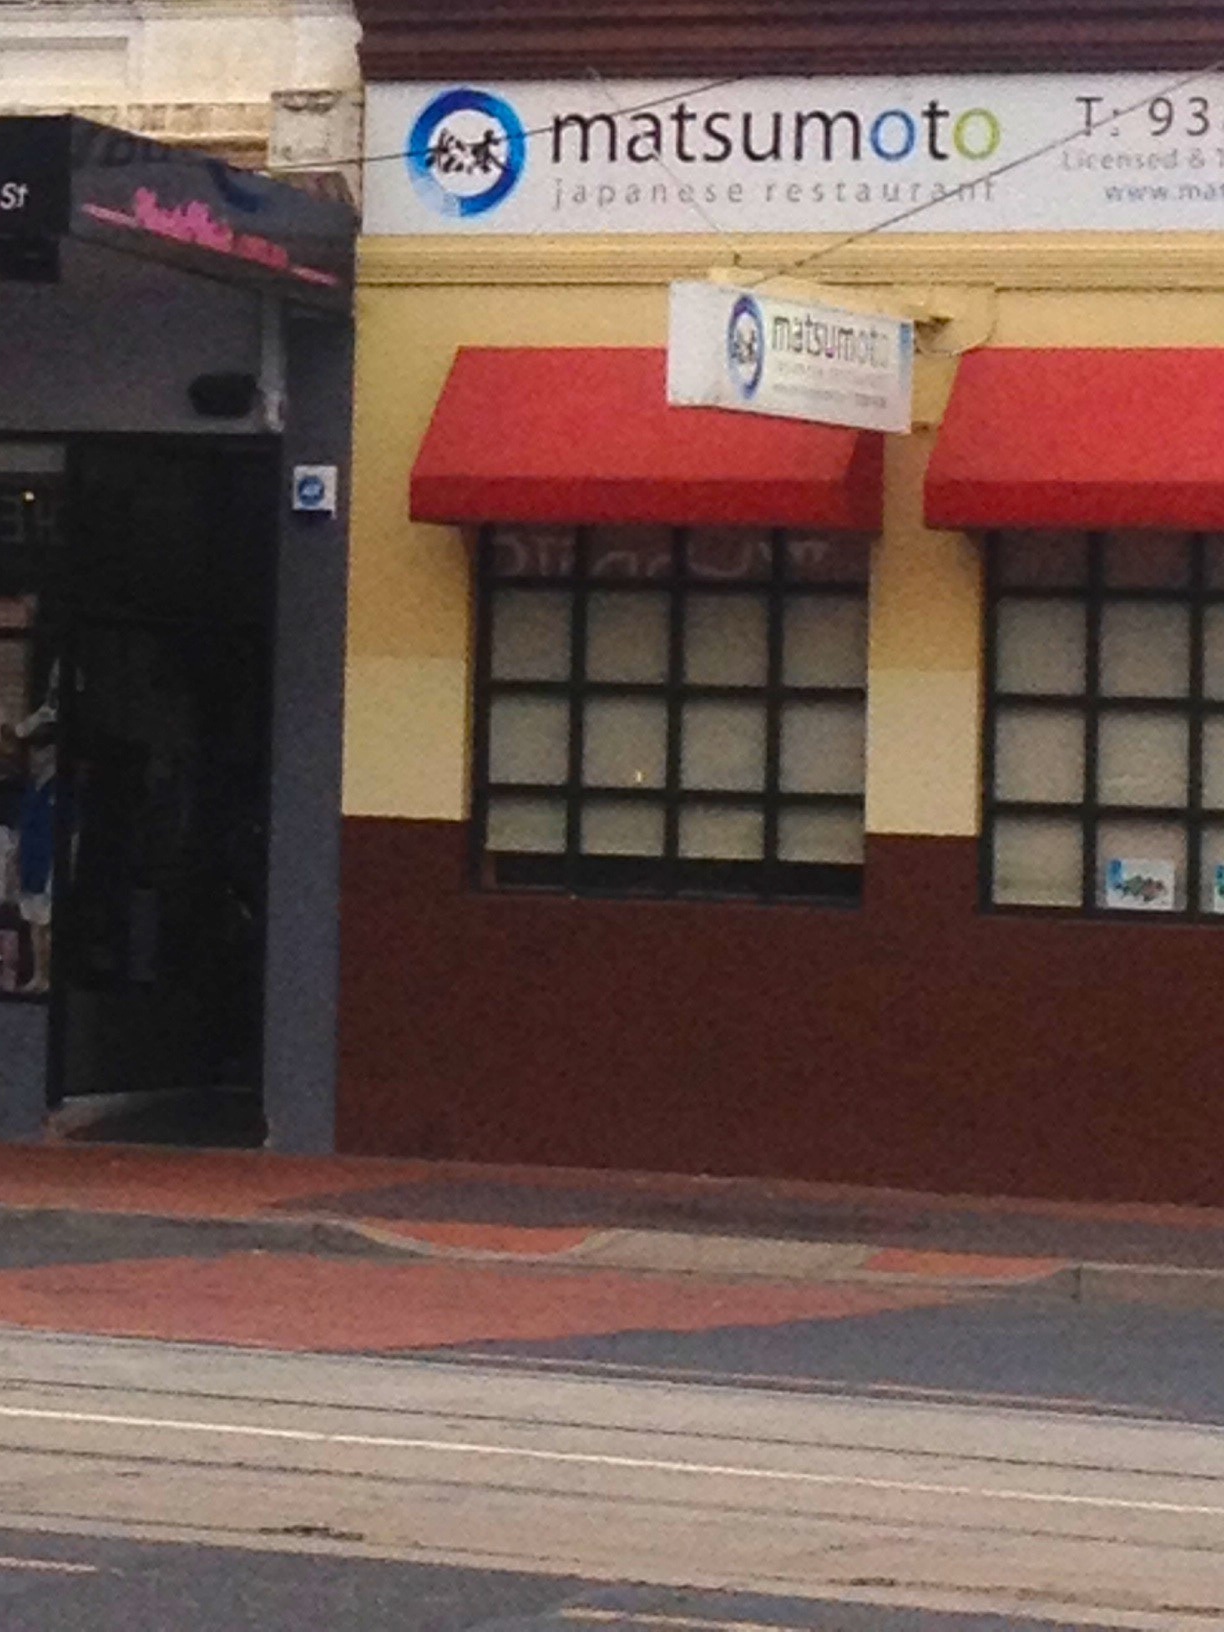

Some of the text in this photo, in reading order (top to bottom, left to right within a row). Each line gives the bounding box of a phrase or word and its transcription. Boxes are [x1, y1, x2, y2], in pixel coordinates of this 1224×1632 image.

[551, 100, 1001, 164] matsumoto
[0, 182, 29, 210] St
[553, 178, 997, 211] japanese restaurant
